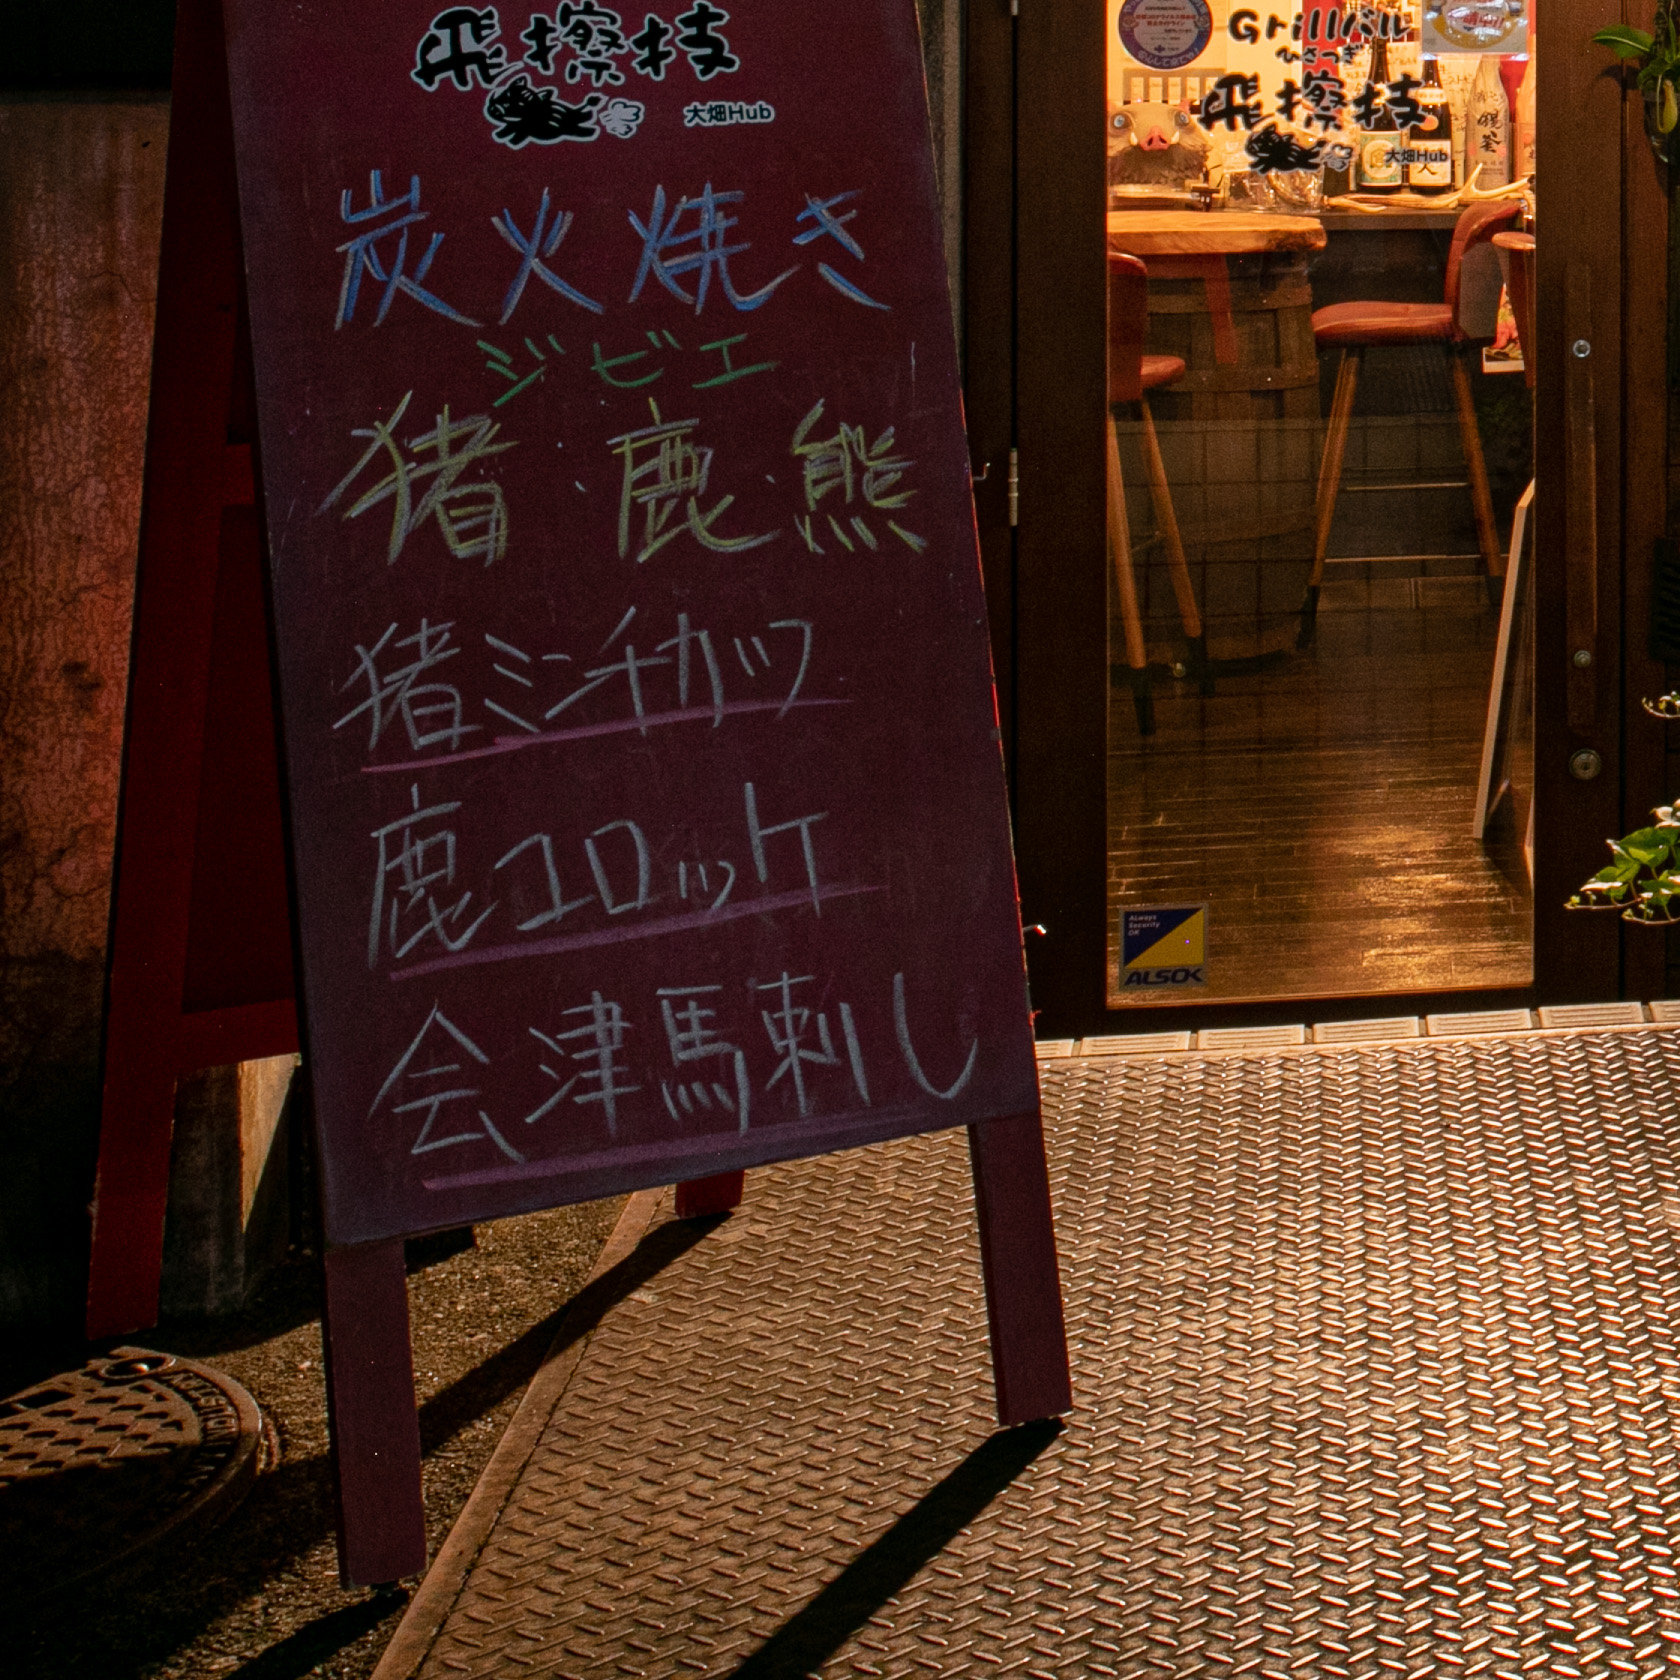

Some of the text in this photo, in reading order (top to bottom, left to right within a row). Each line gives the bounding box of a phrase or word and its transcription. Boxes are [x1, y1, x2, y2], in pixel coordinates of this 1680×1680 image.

[1275, 43, 1367, 65] ひさつぎ
[684, 101, 775, 126] 大畑Hub
[1384, 147, 1448, 165] 大畑Hub
[334, 168, 893, 330] 炭火焼き
[476, 328, 779, 408] ジビエ
[332, 606, 814, 750] 猪ミンチカツ
[369, 782, 830, 970] 鹿コロッケ
[1124, 968, 1204, 986] ALSOK
[368, 972, 979, 1164] 会津馬刺し
